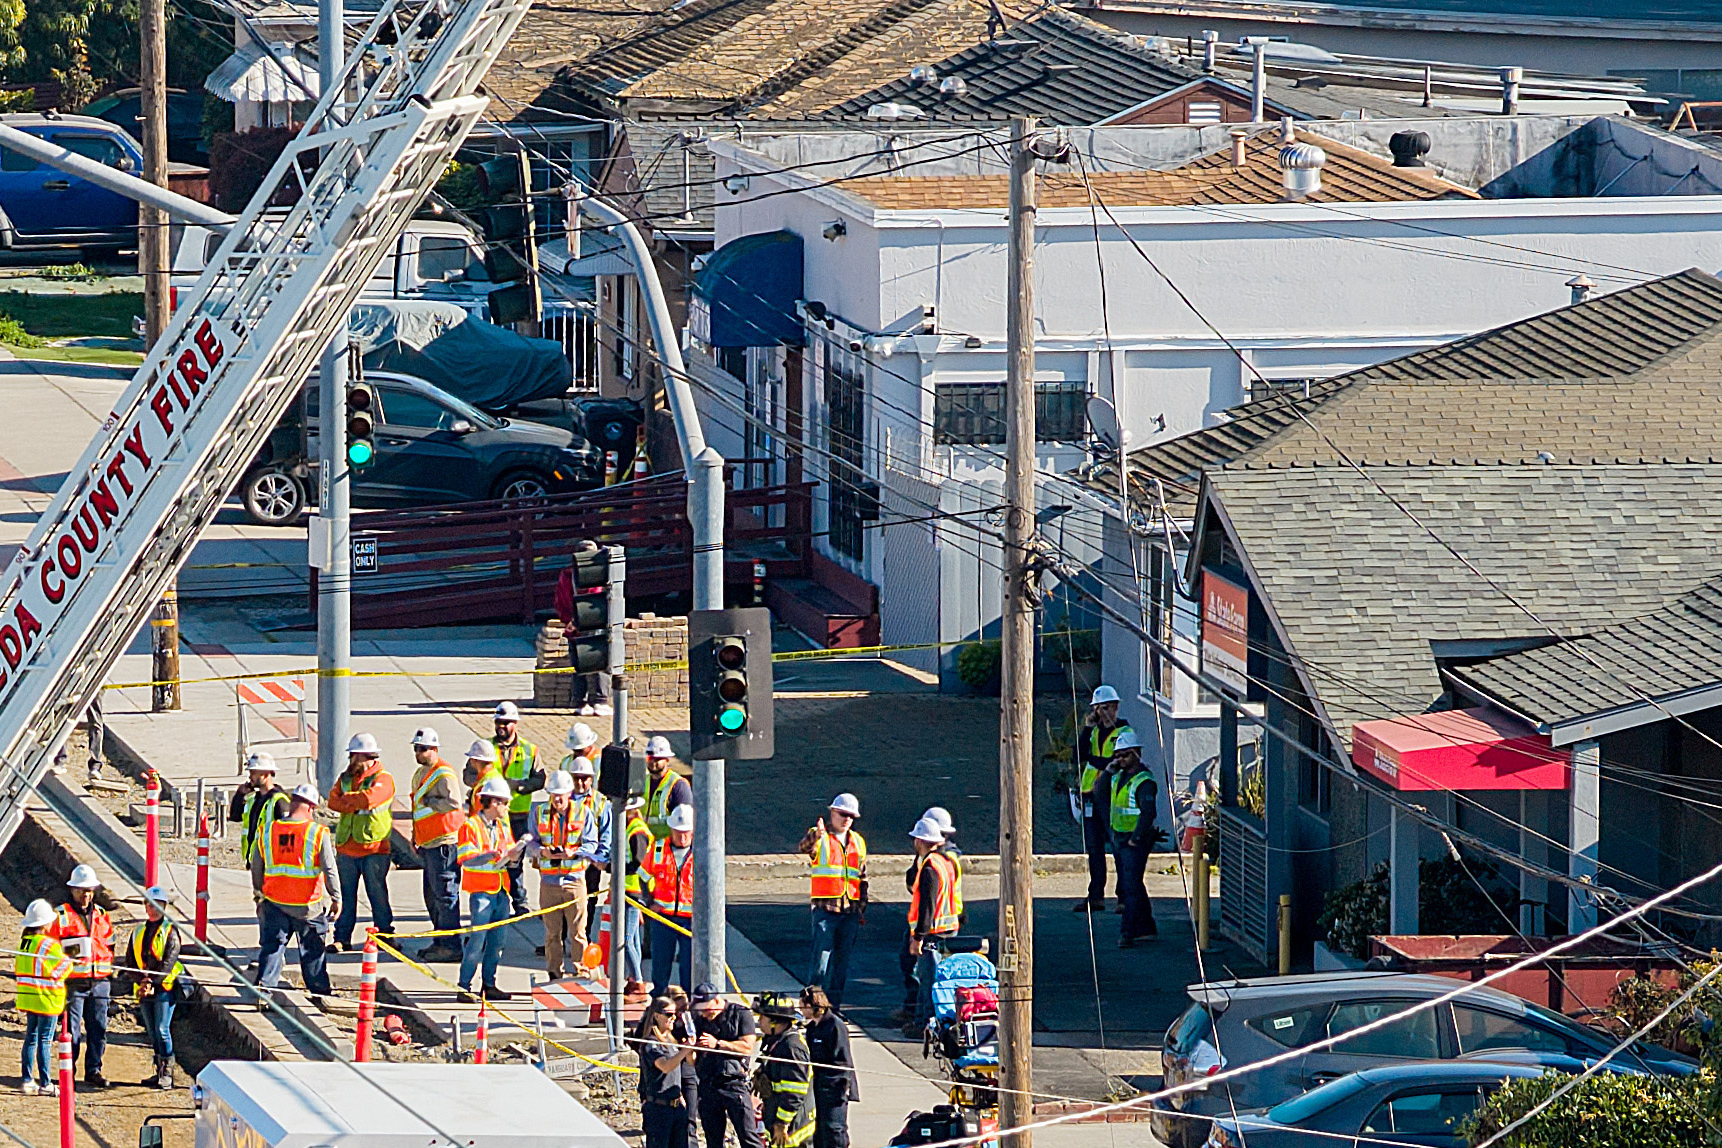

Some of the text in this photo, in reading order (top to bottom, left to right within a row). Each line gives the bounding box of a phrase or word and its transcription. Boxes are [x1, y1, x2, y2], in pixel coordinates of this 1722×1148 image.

[101, 416, 116, 433] 100
[40, 420, 154, 605] COUNTY
[150, 317, 225, 439] FIRE
[354, 543, 375, 554] CASH
[14, 551, 27, 565] 90
[355, 555, 375, 567] ONLY
